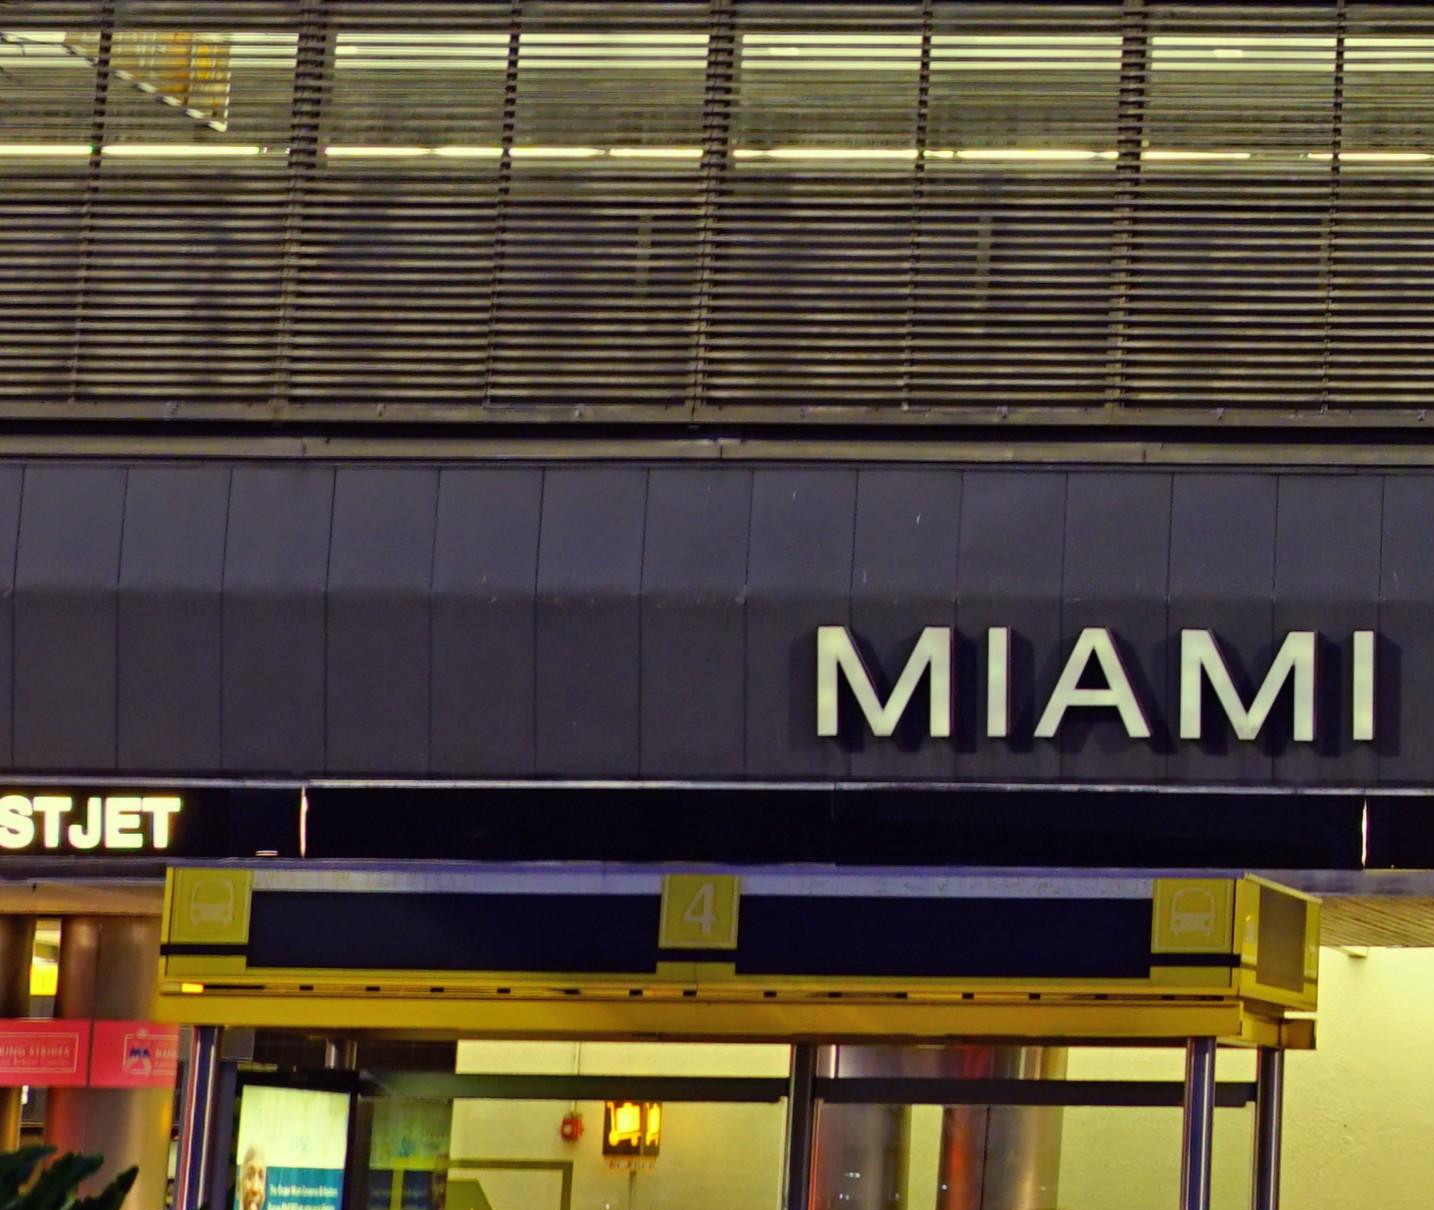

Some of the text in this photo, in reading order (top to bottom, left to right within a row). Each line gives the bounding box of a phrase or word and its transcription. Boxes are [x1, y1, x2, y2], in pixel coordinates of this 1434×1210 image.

[816, 625, 1375, 742] MIAMI
[0, 795, 182, 849] STJET
[683, 881, 718, 936] 4
